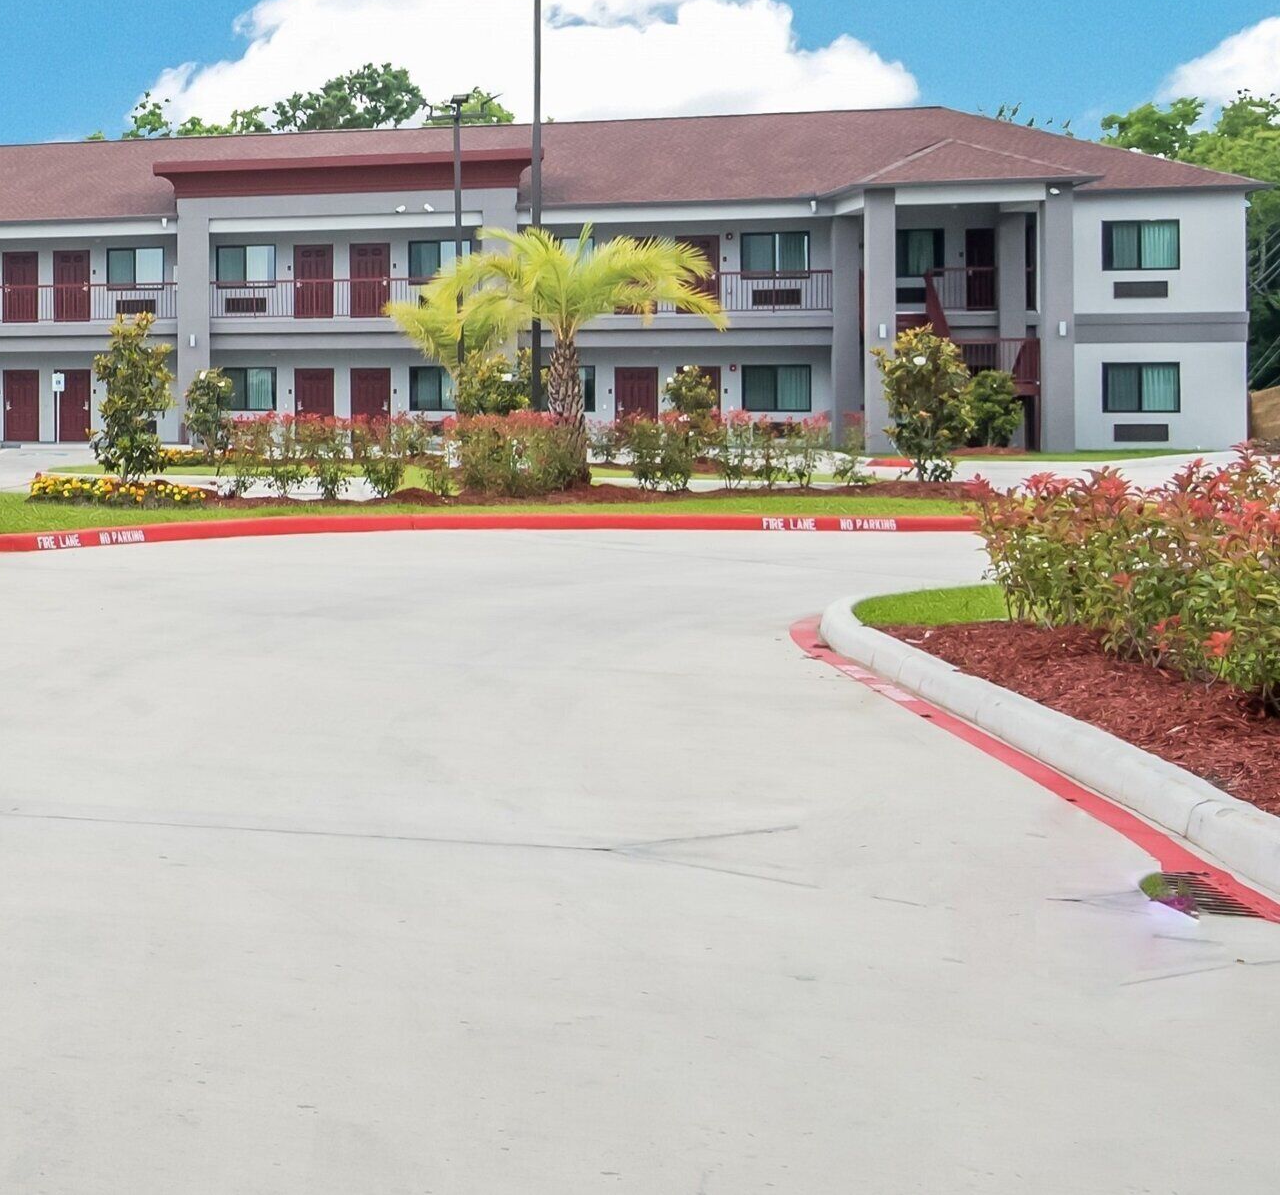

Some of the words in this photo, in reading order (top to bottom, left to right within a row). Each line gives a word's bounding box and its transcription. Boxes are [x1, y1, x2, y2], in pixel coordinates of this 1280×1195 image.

[762, 517, 785, 531] FIRE
[789, 518, 816, 531] LANE
[840, 519, 854, 531] NO
[855, 518, 897, 531] PARKING
[37, 536, 57, 550] FIRE
[59, 534, 82, 547] LANE
[99, 531, 111, 545] NO
[111, 530, 145, 543] PARKING
